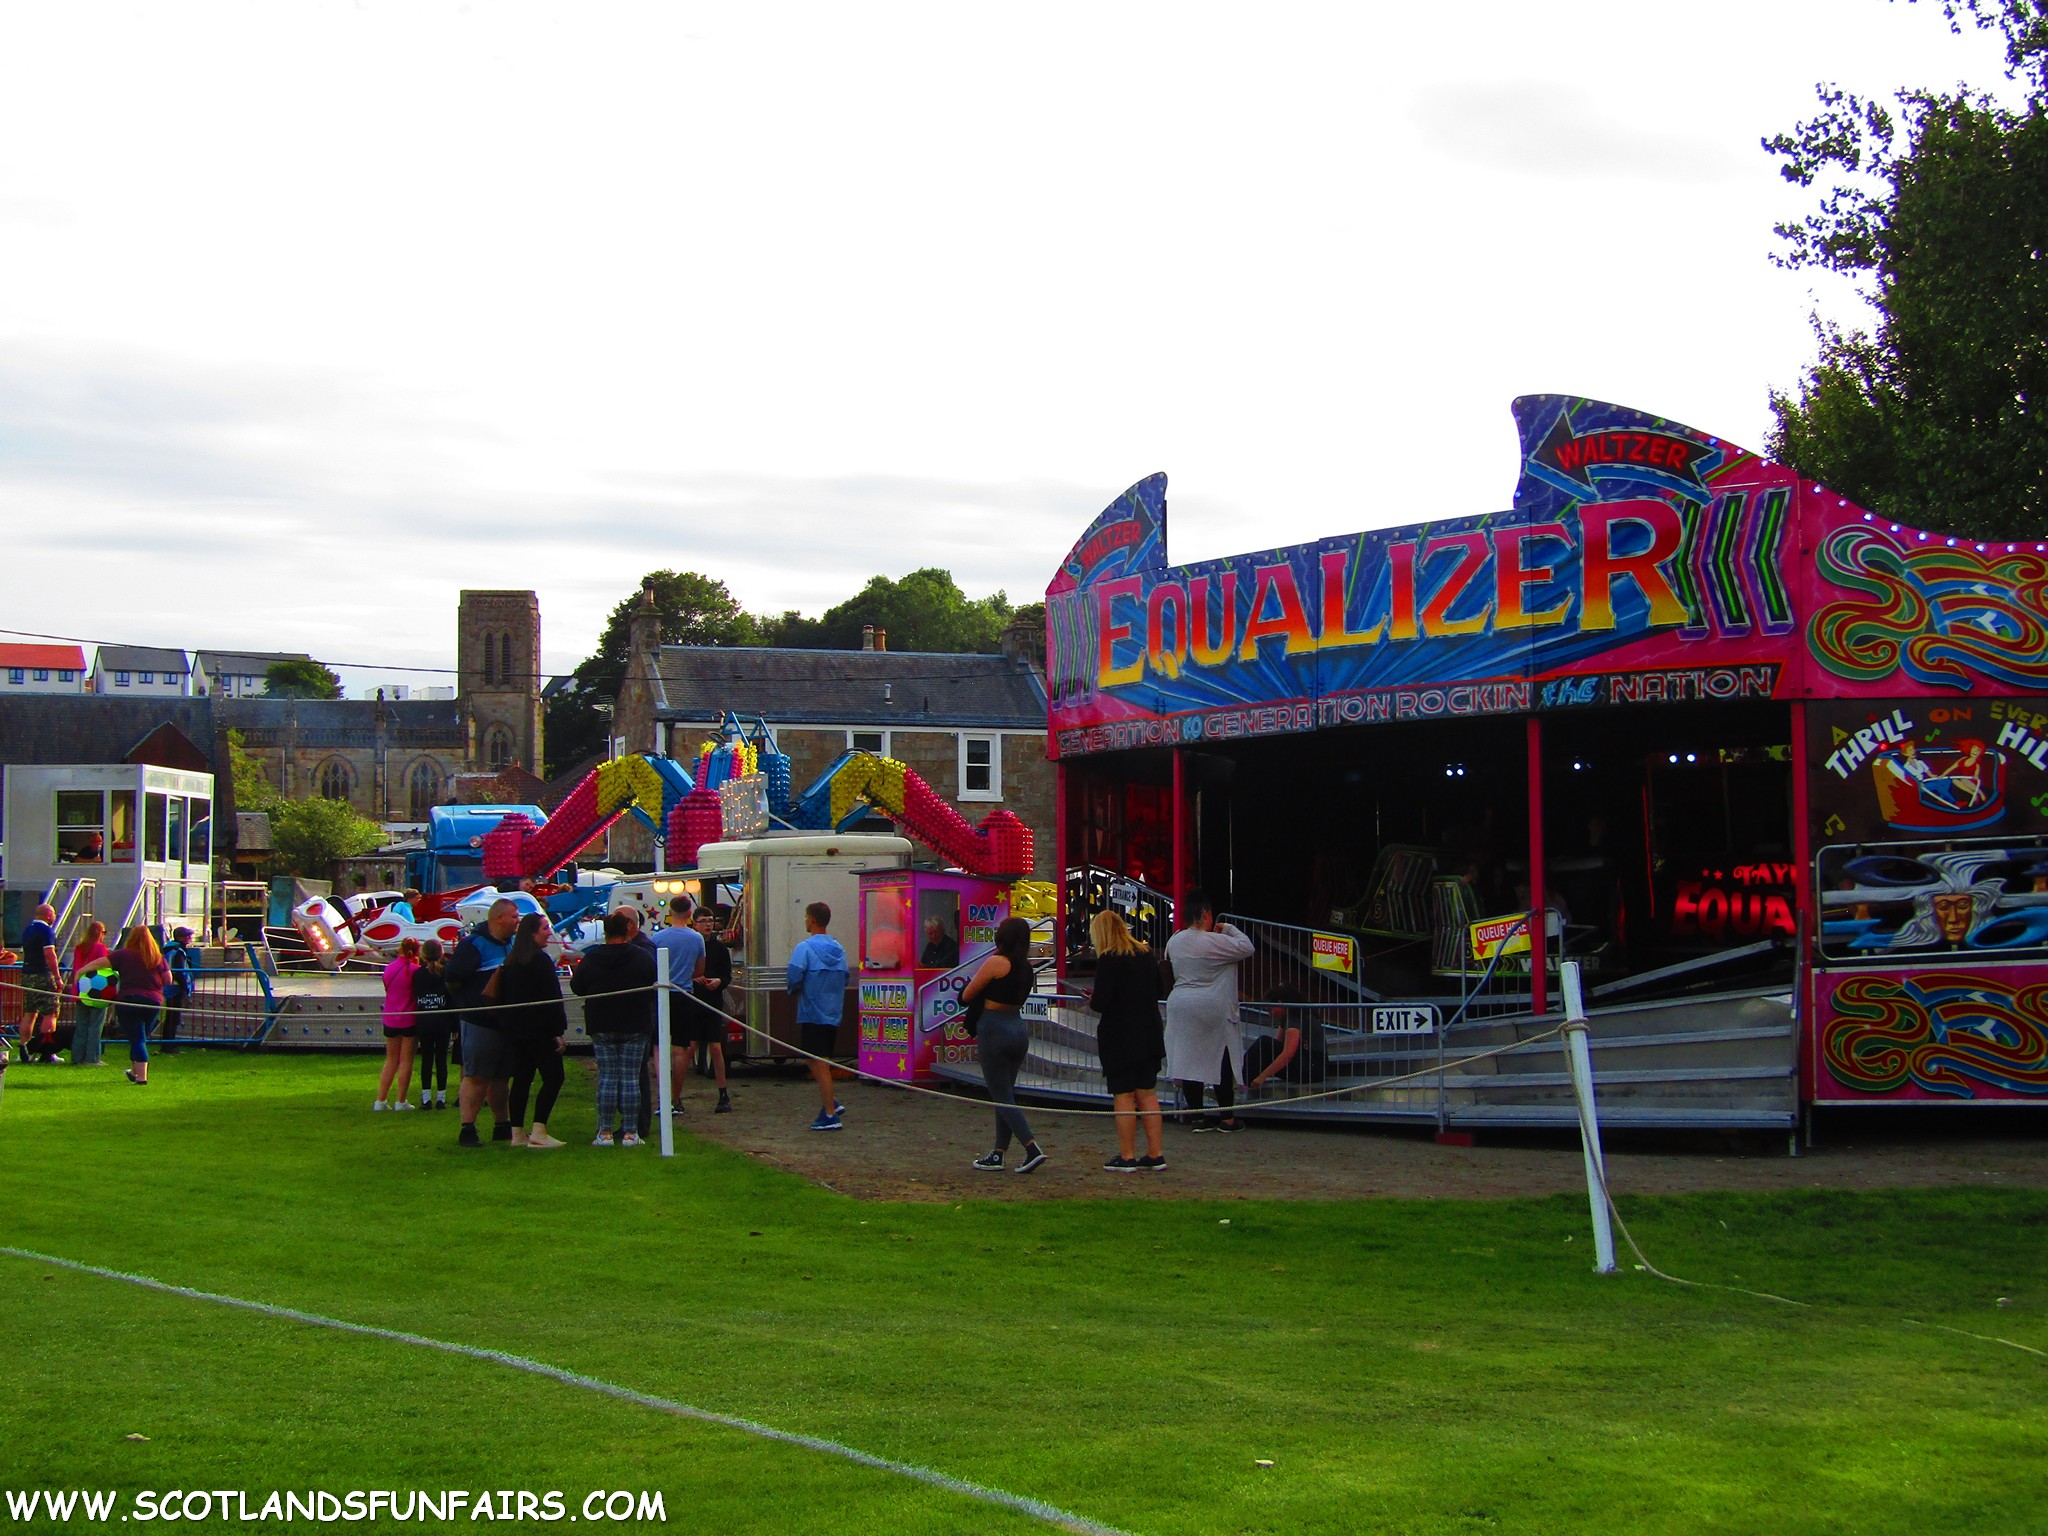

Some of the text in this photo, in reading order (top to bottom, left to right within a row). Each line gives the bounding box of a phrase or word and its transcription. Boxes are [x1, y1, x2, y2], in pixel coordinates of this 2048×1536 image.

[1556, 433, 1688, 471] WALTZER
[1082, 521, 1142, 568] WALTZER
[1097, 498, 1690, 690] EQUALIZER
[1058, 719, 1179, 753] GENERATION
[1204, 692, 1390, 737] GENERATION
[1396, 682, 1530, 718] ROCKIN
[1609, 667, 1772, 704] NATION
[1929, 707, 1973, 723] ON
[1990, 701, 2048, 732] EVER
[1824, 709, 1914, 779] THRILL
[1832, 726, 1849, 746] A
[968, 904, 998, 922] PAY
[964, 926, 998, 943] HER
[1478, 924, 1506, 942] QUEUE
[1313, 939, 1348, 955] QUEUE HERE
[862, 984, 908, 1010] WALTZER
[862, 1016, 908, 1042] PAY HERE
[944, 1022, 972, 1040] YO
[1376, 1010, 1411, 1031] EXIT
